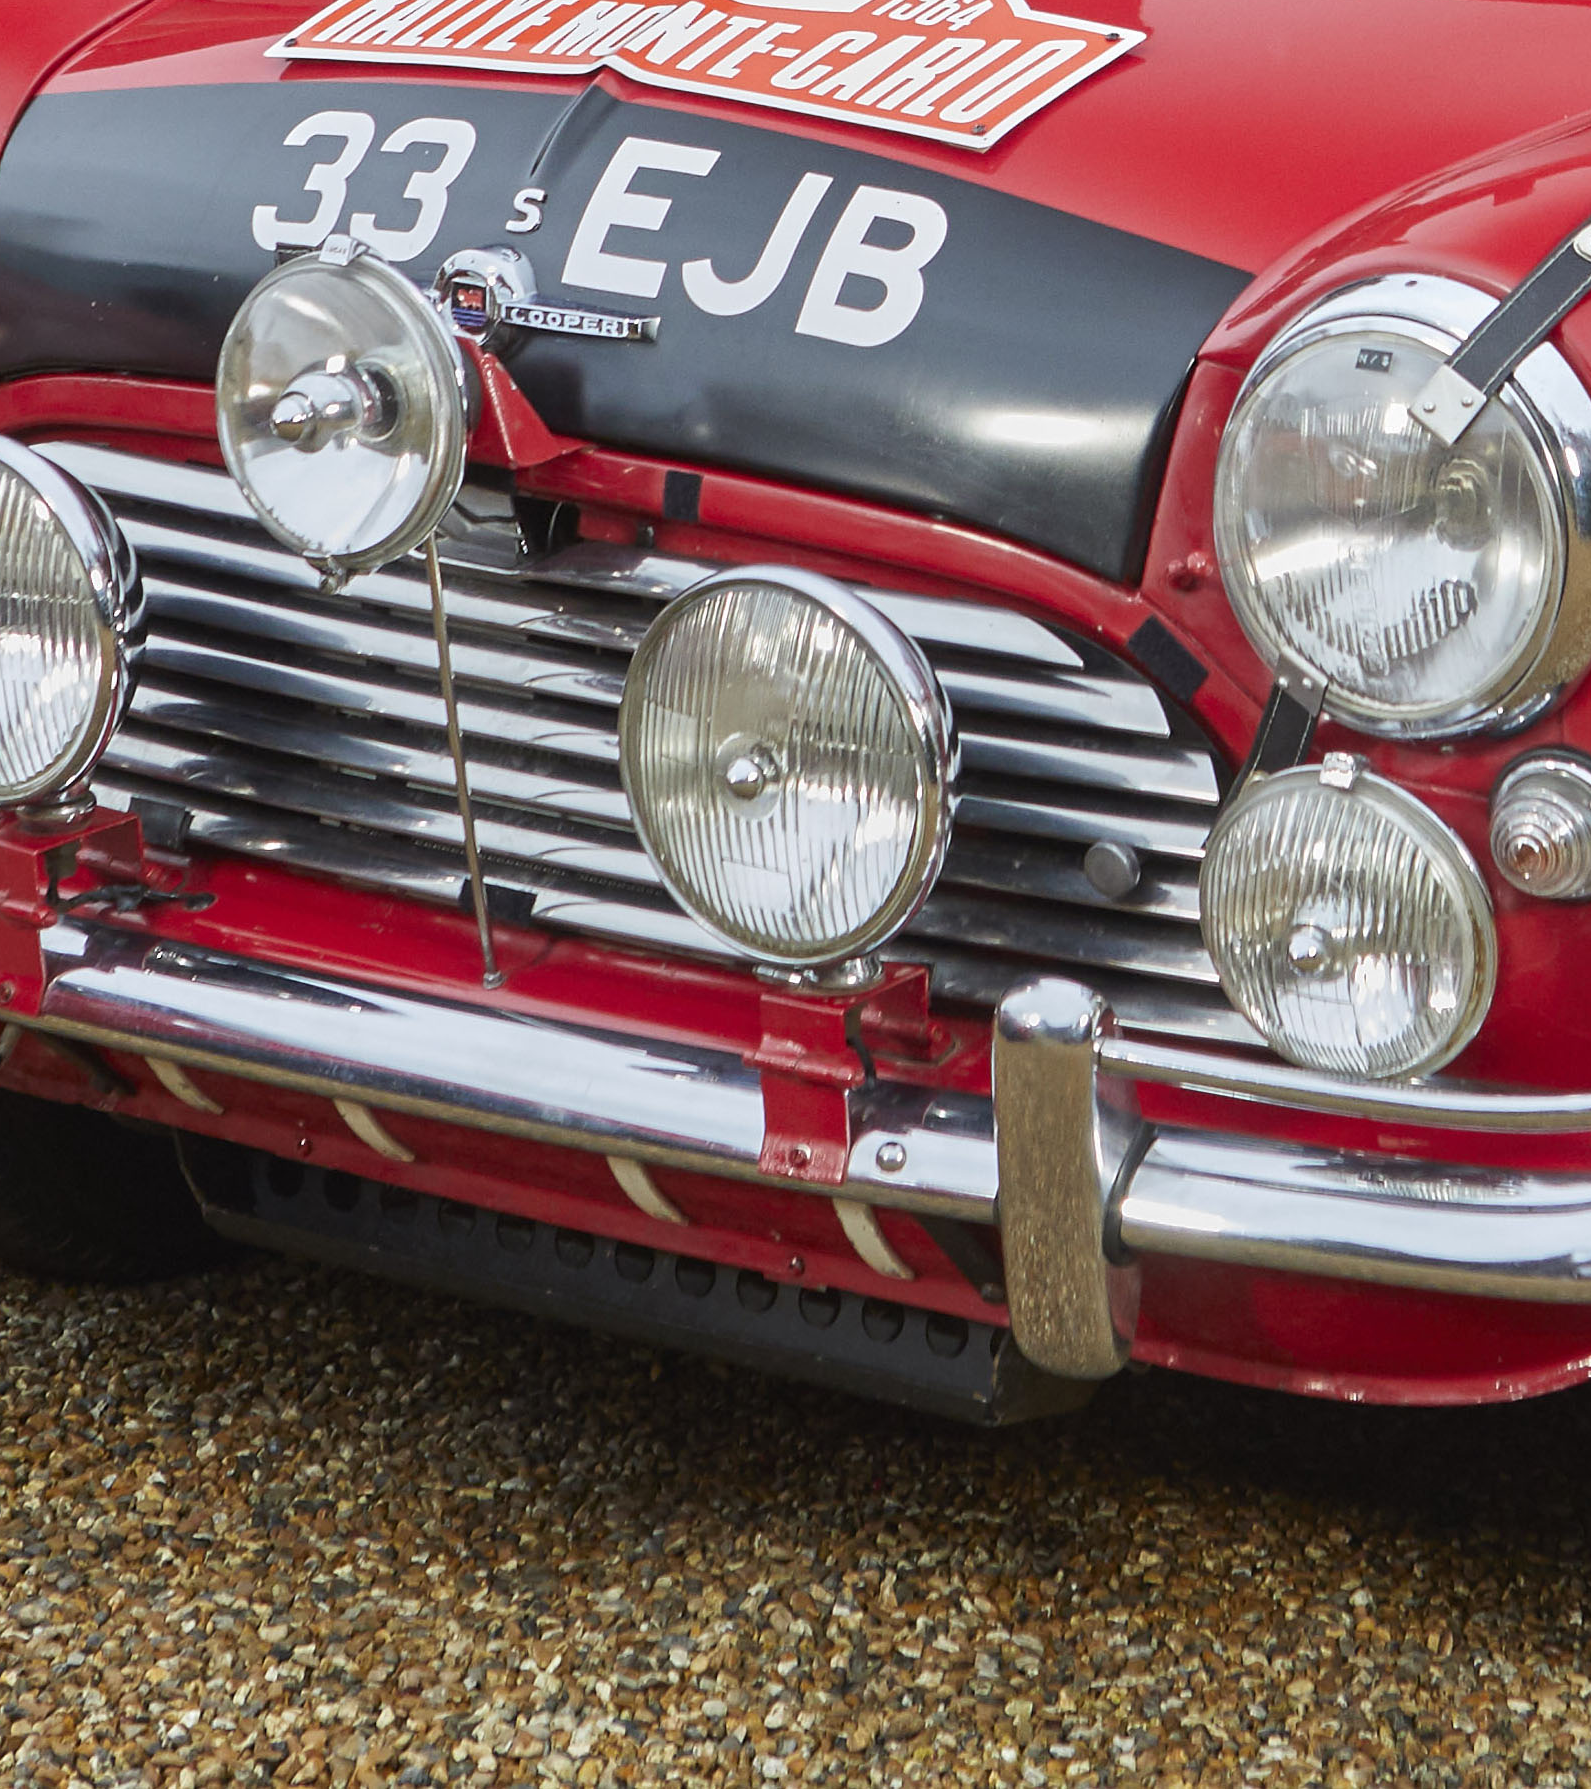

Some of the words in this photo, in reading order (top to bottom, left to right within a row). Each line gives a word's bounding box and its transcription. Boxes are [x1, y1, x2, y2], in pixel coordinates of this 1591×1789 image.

[251, 110, 476, 262] 33
[562, 137, 948, 347] EJB
[510, 307, 621, 336] COOPER
